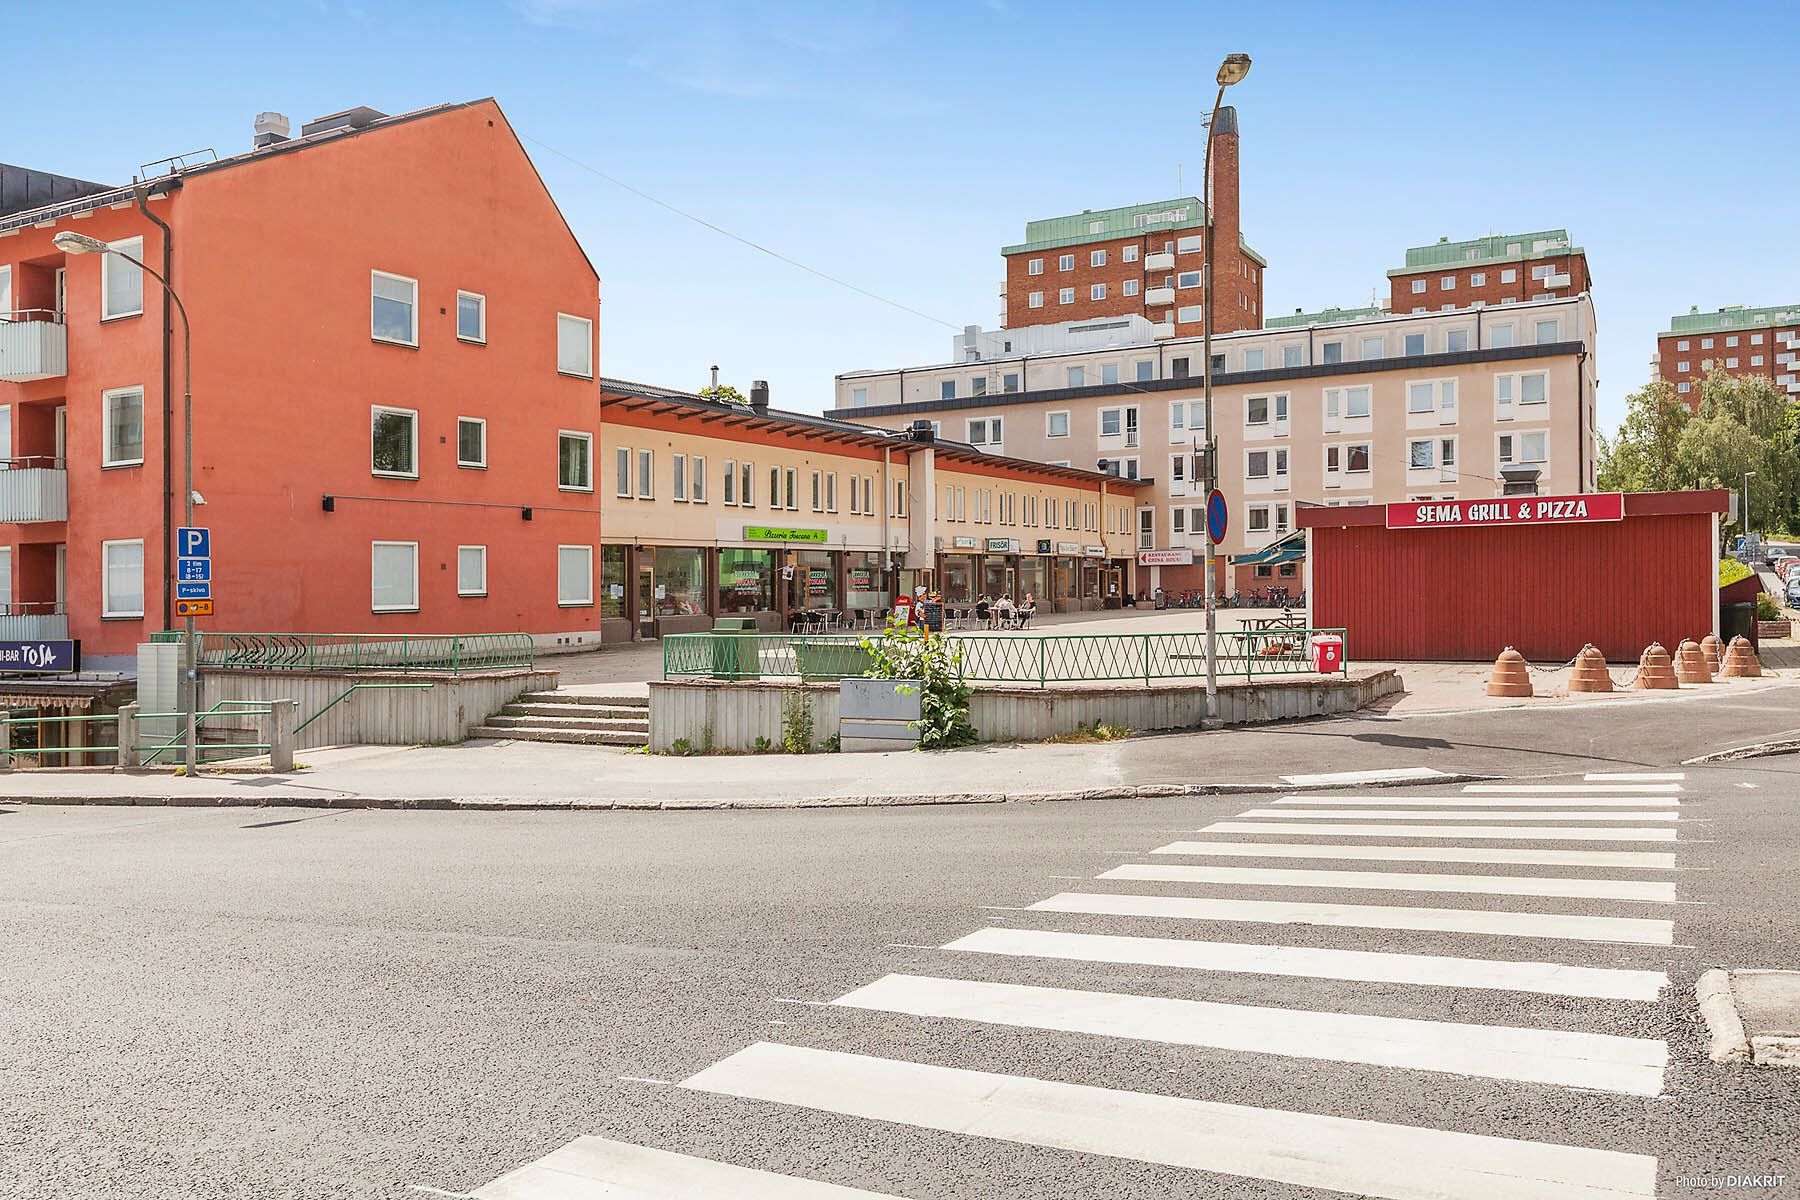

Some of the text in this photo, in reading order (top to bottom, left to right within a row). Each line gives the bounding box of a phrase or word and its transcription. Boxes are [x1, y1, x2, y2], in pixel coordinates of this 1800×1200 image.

[1416, 500, 1588, 523] SEMA GRILL & PIZZA
[187, 530, 203, 555] P
[990, 540, 1008, 549] FRISÖR
[0, 643, 57, 668] I-BAR TOSA
